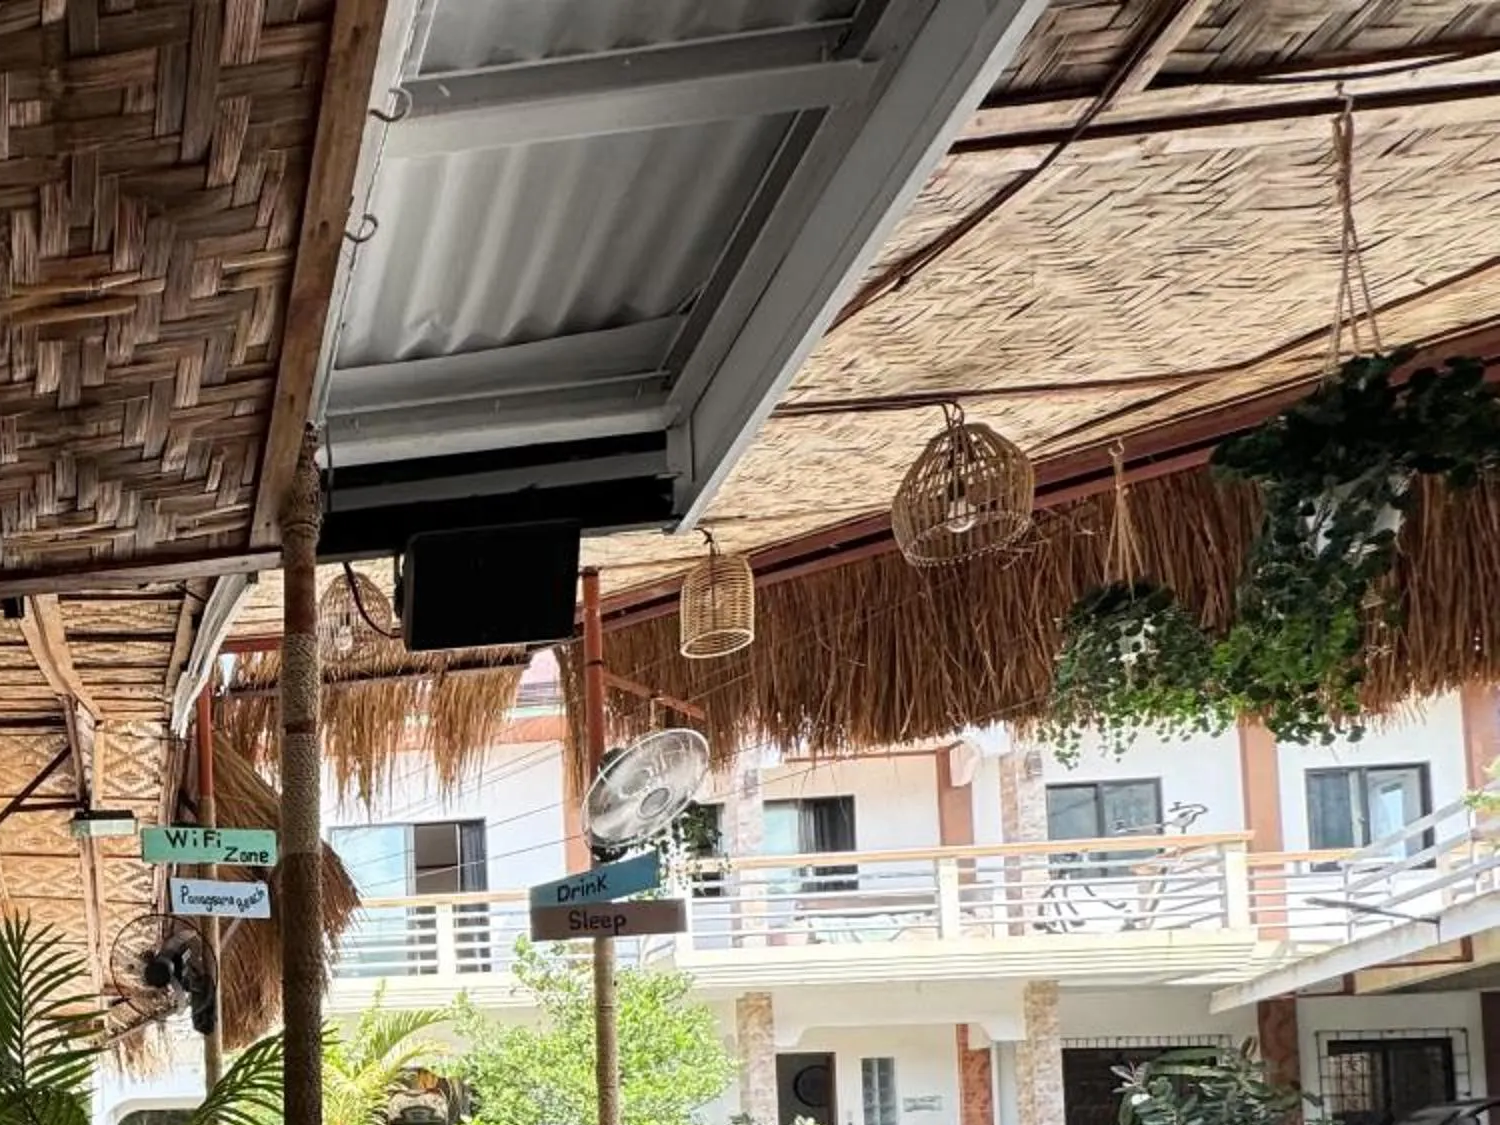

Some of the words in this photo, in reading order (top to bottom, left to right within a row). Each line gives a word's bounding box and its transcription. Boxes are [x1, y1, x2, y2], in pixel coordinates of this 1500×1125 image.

[165, 829, 221, 848] WiFi
[223, 847, 269, 864] Zone
[557, 873, 608, 902] Drink
[568, 910, 627, 935] Sleep
